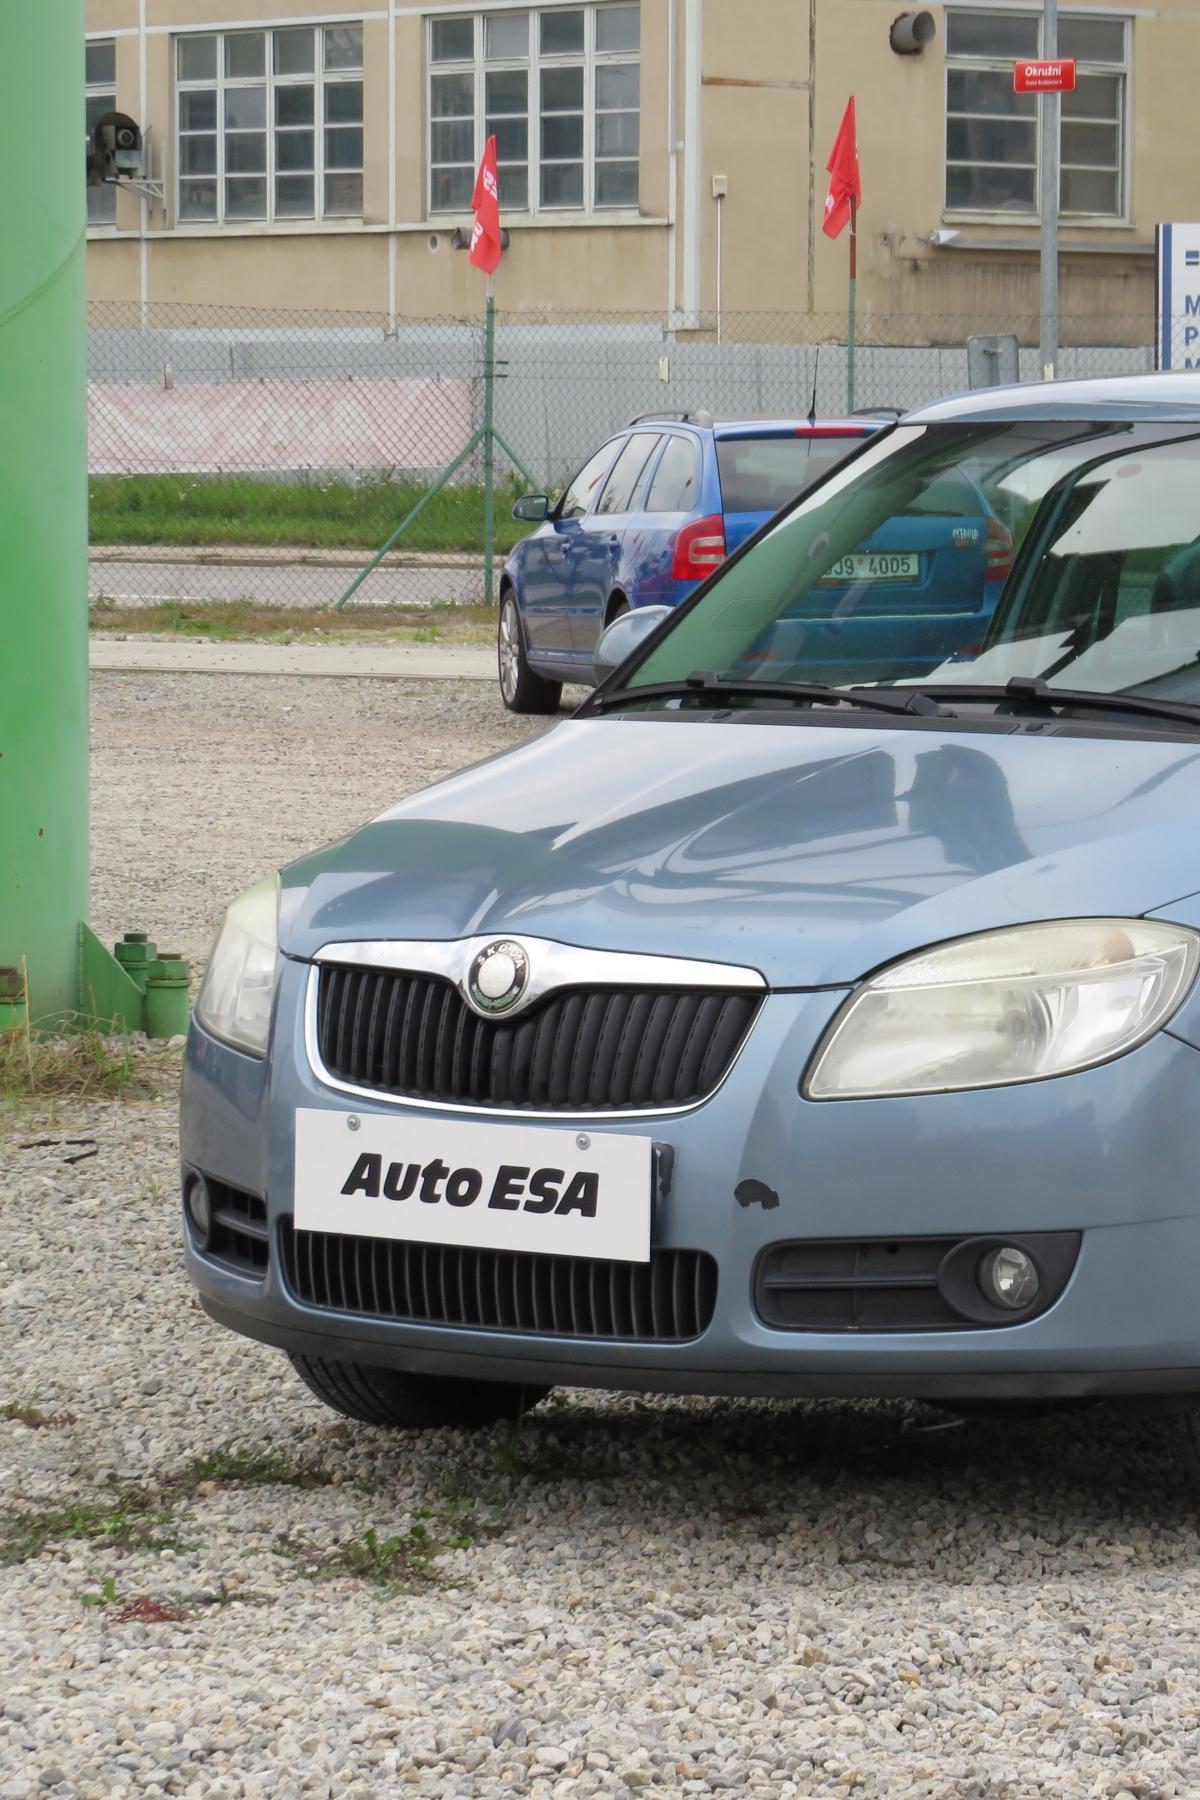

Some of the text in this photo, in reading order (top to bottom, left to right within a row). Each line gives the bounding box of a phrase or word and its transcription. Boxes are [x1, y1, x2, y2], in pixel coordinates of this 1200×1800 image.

[825, 557, 911, 576] J9 4005
[340, 1152, 600, 1218] Auto ESA
